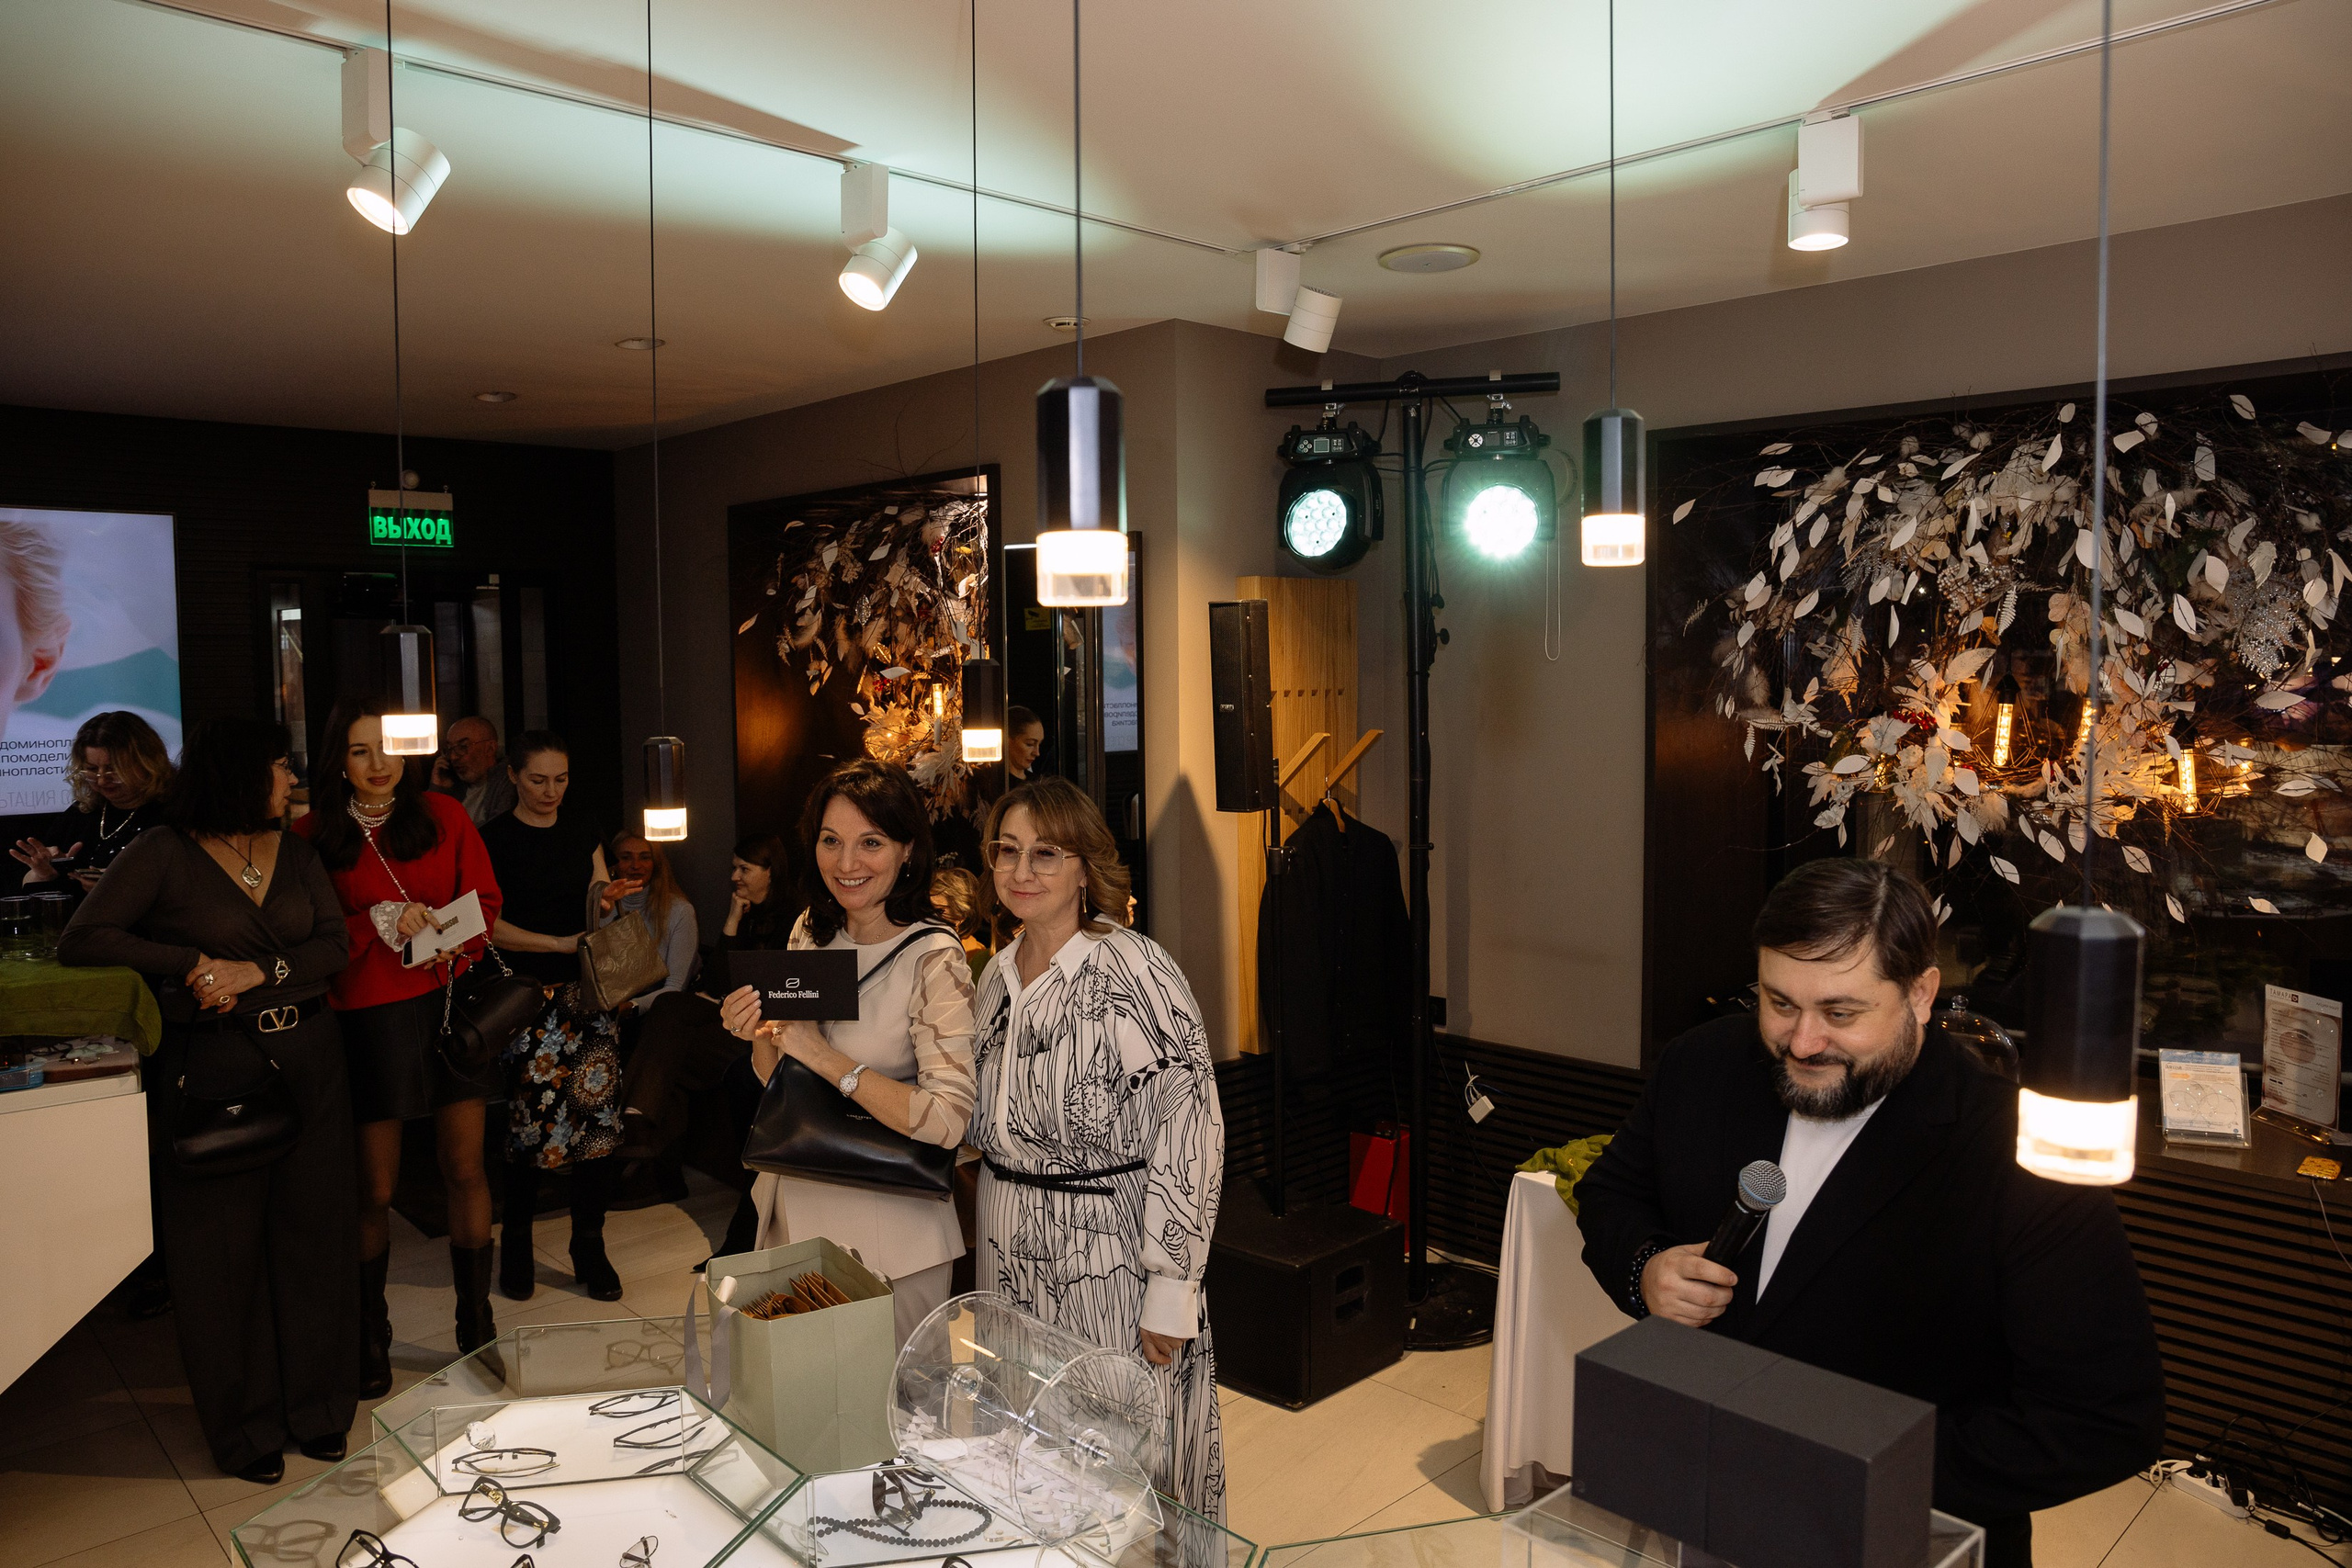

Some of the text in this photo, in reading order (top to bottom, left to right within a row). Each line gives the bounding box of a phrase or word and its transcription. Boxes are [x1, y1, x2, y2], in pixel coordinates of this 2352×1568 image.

[373, 516, 452, 545] ВЫХОД
[0, 739, 74, 751] доминопл
[0, 766, 65, 777] нопласти
[768, 990, 820, 998] Federico Fellini
